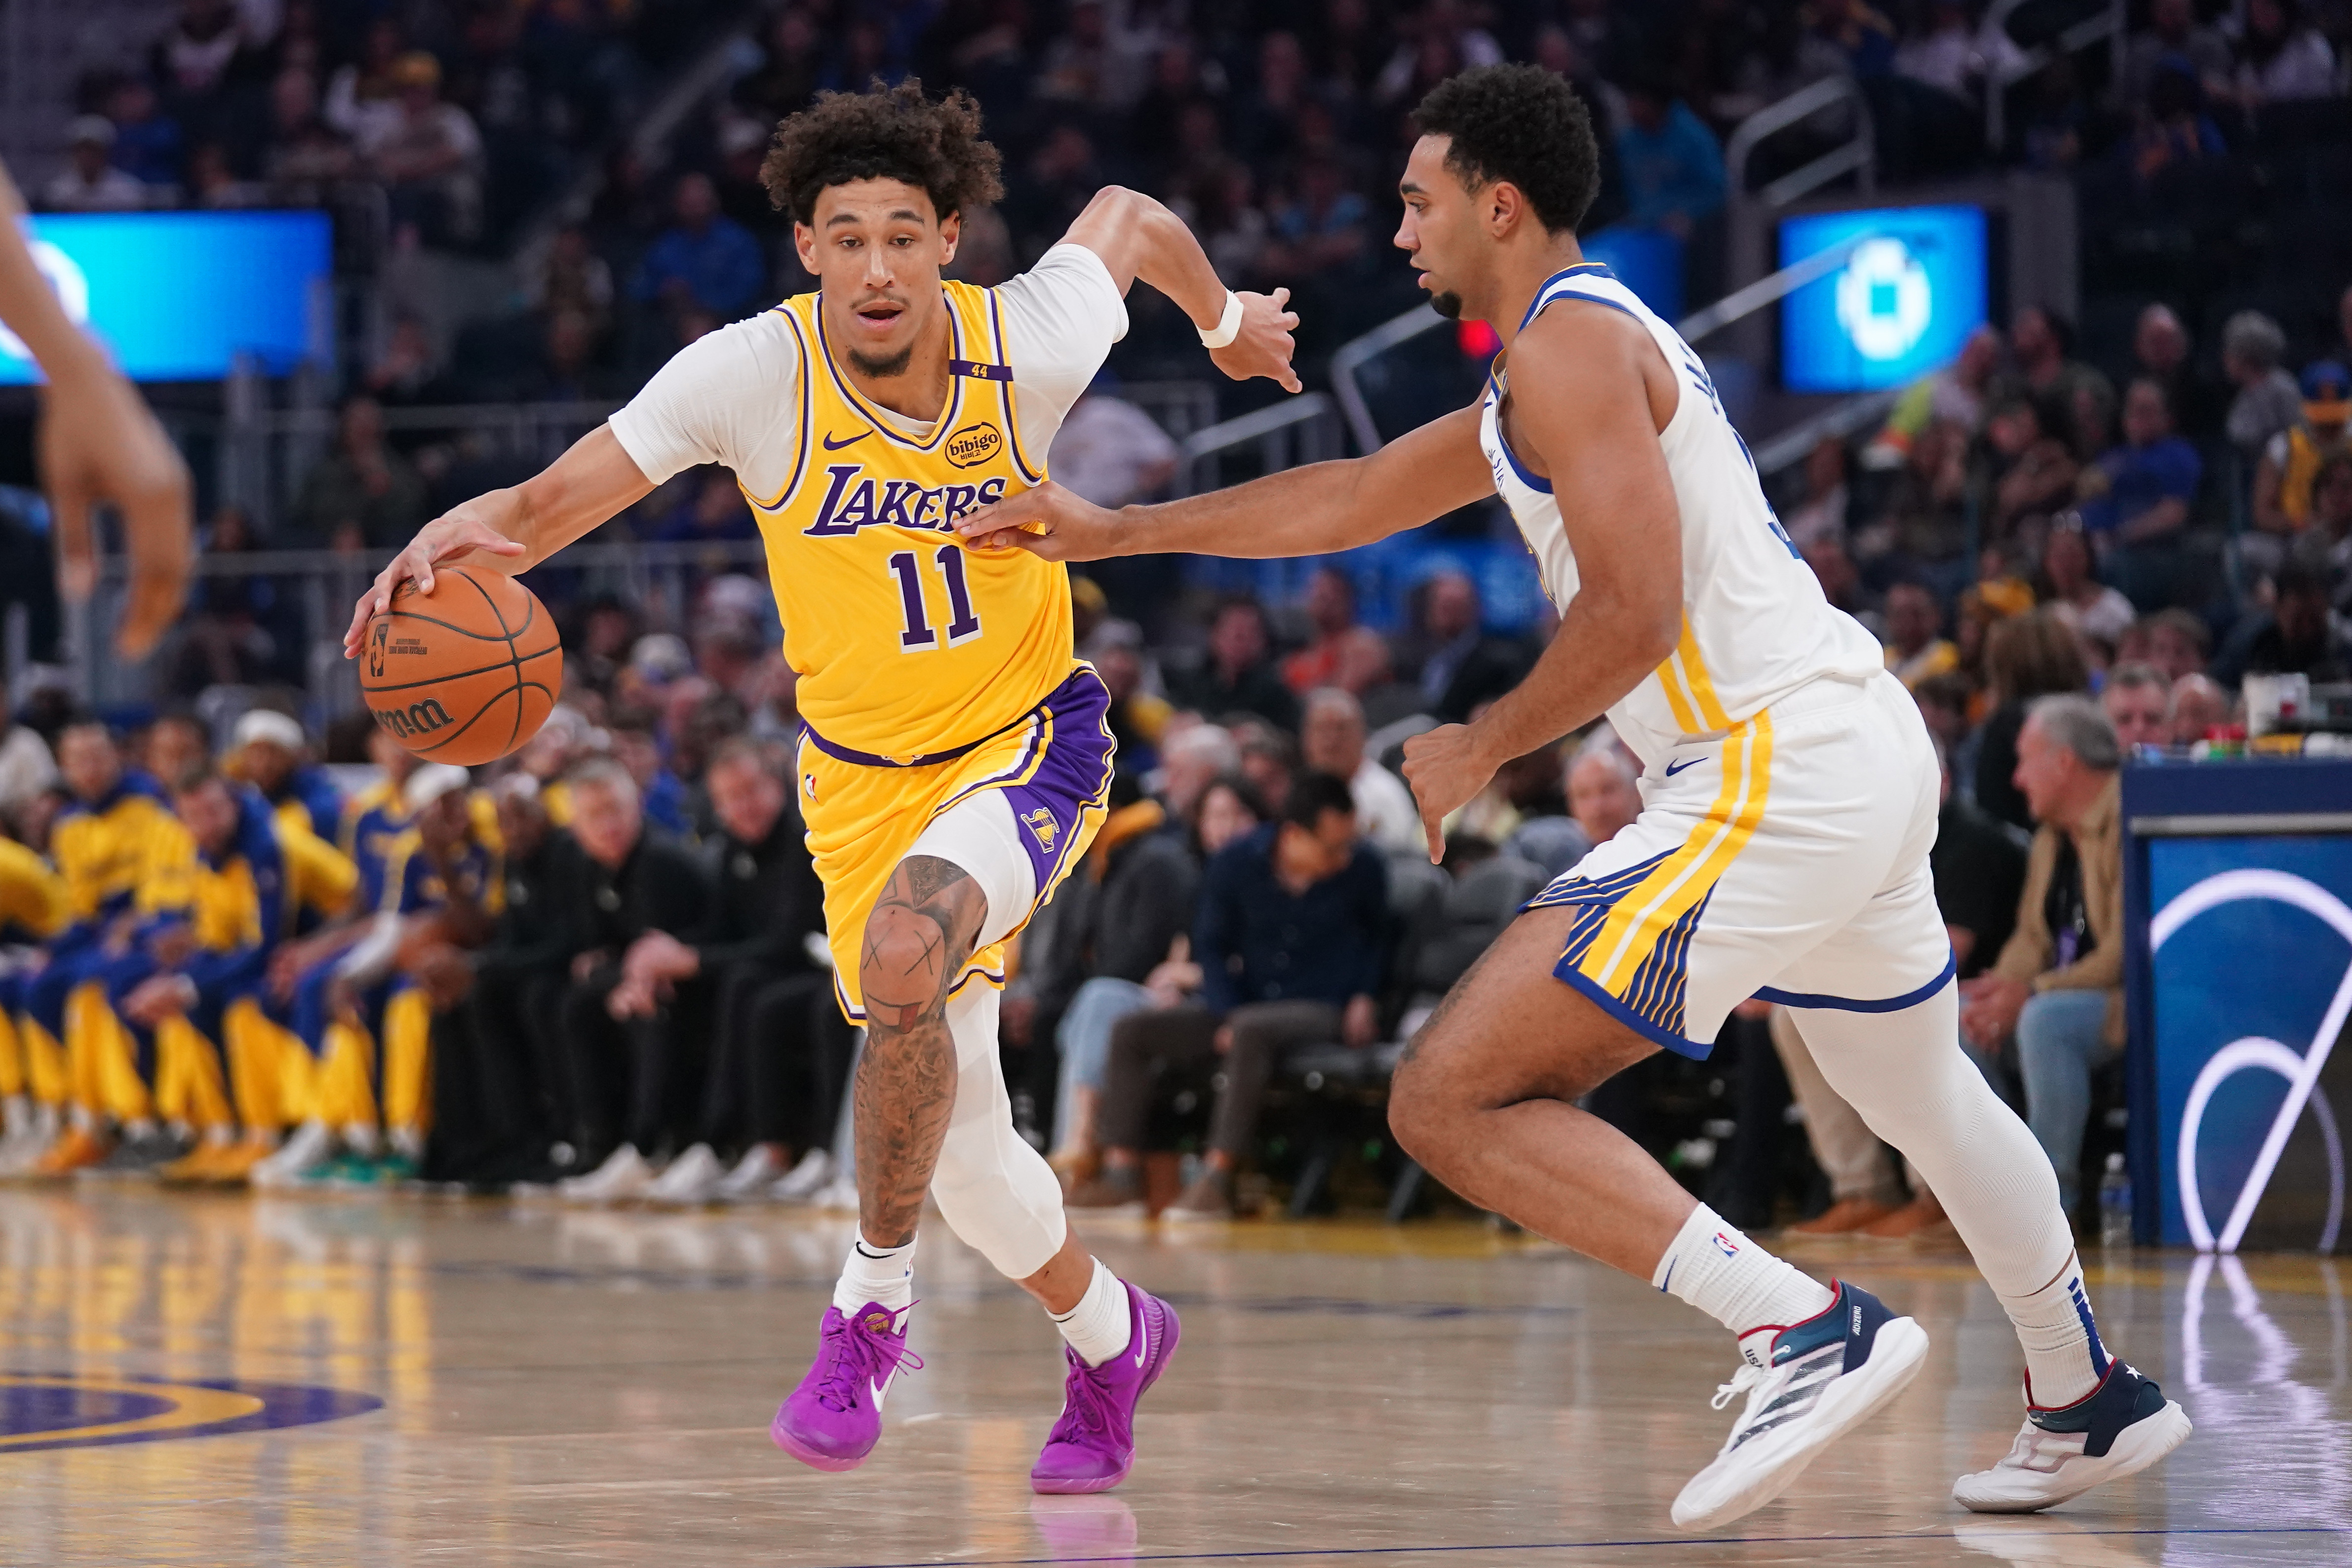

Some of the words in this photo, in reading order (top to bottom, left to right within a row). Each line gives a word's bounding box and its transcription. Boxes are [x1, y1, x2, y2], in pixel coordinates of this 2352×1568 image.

[972, 364, 987, 377] 44
[949, 434, 998, 456] bibigo
[960, 449, 981, 460] 비비고
[887, 544, 982, 654] 11
[1852, 1305, 1862, 1336] ADIZERO
